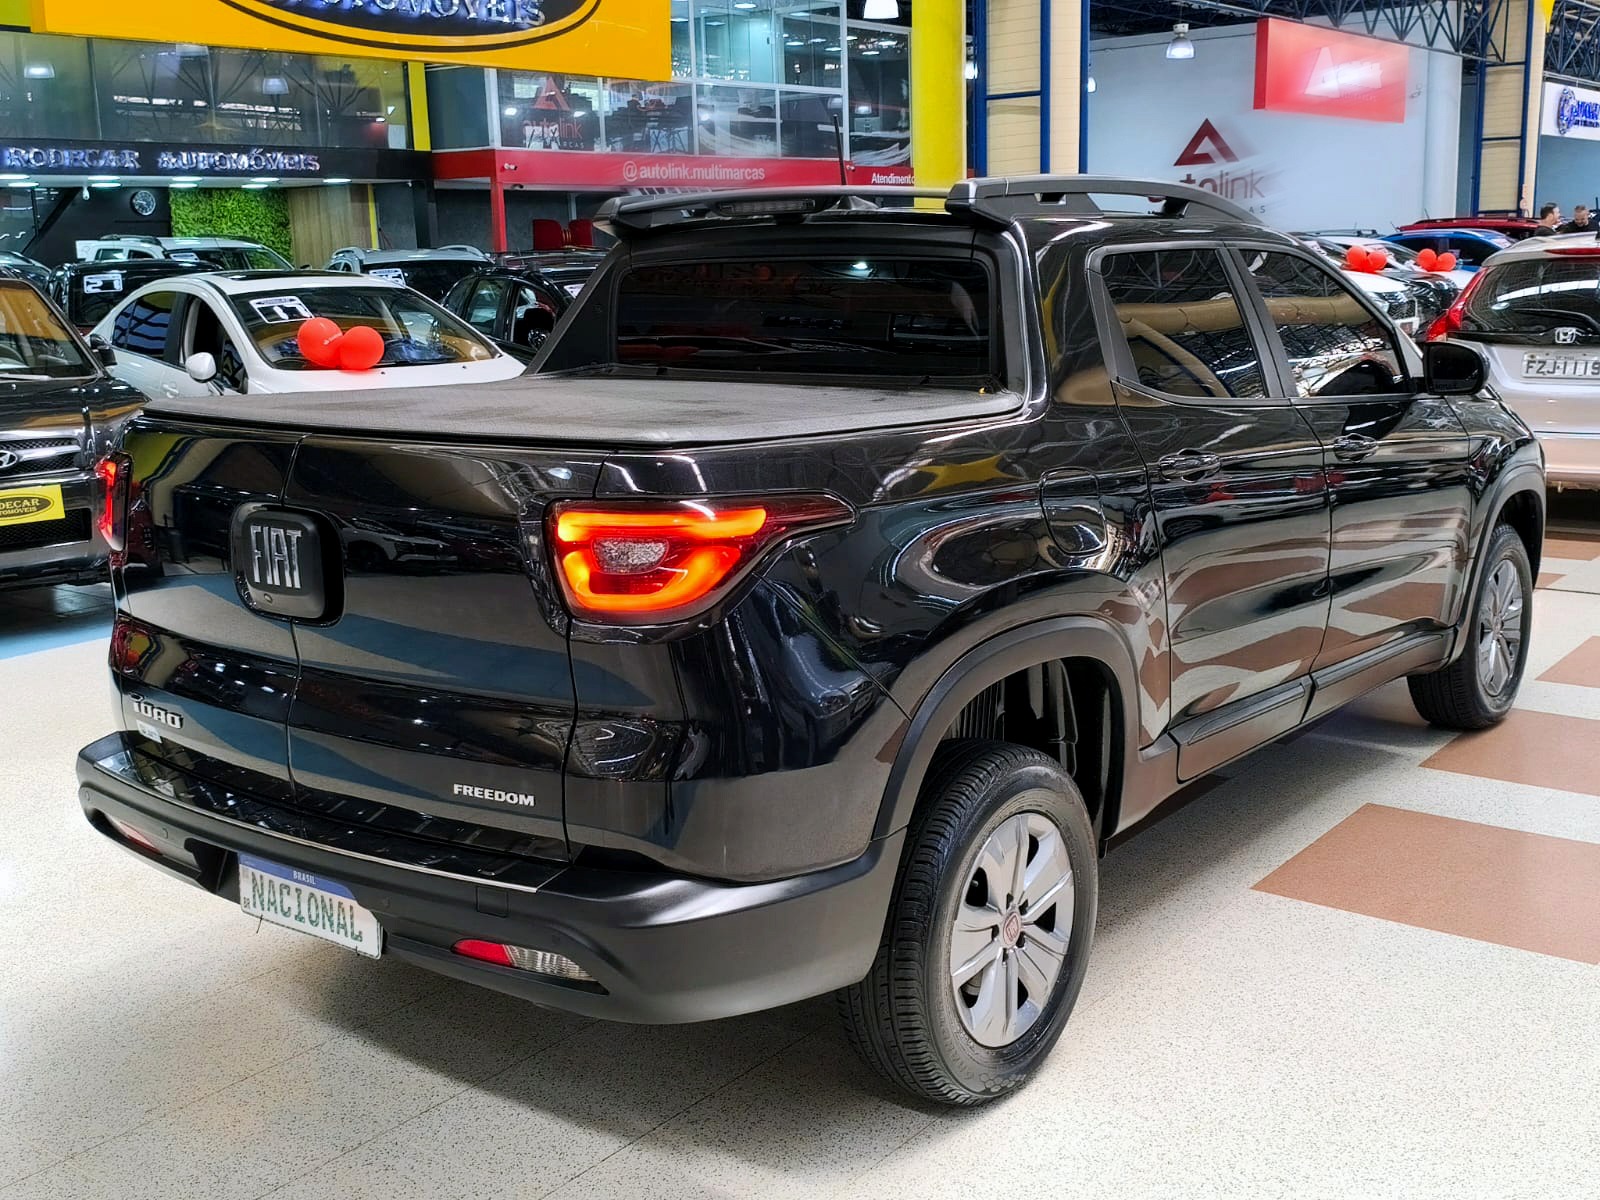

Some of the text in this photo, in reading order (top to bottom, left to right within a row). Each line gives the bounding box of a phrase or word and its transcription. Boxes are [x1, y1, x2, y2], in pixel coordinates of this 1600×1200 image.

[7, 147, 321, 171] RODECAR AUTOMÓVEIS
[250, 525, 302, 589] FIAT
[130, 692, 183, 729] TORO
[453, 783, 535, 807] FREEDOM
[293, 870, 317, 885] BRASIL
[251, 871, 363, 942] NACIONAL
